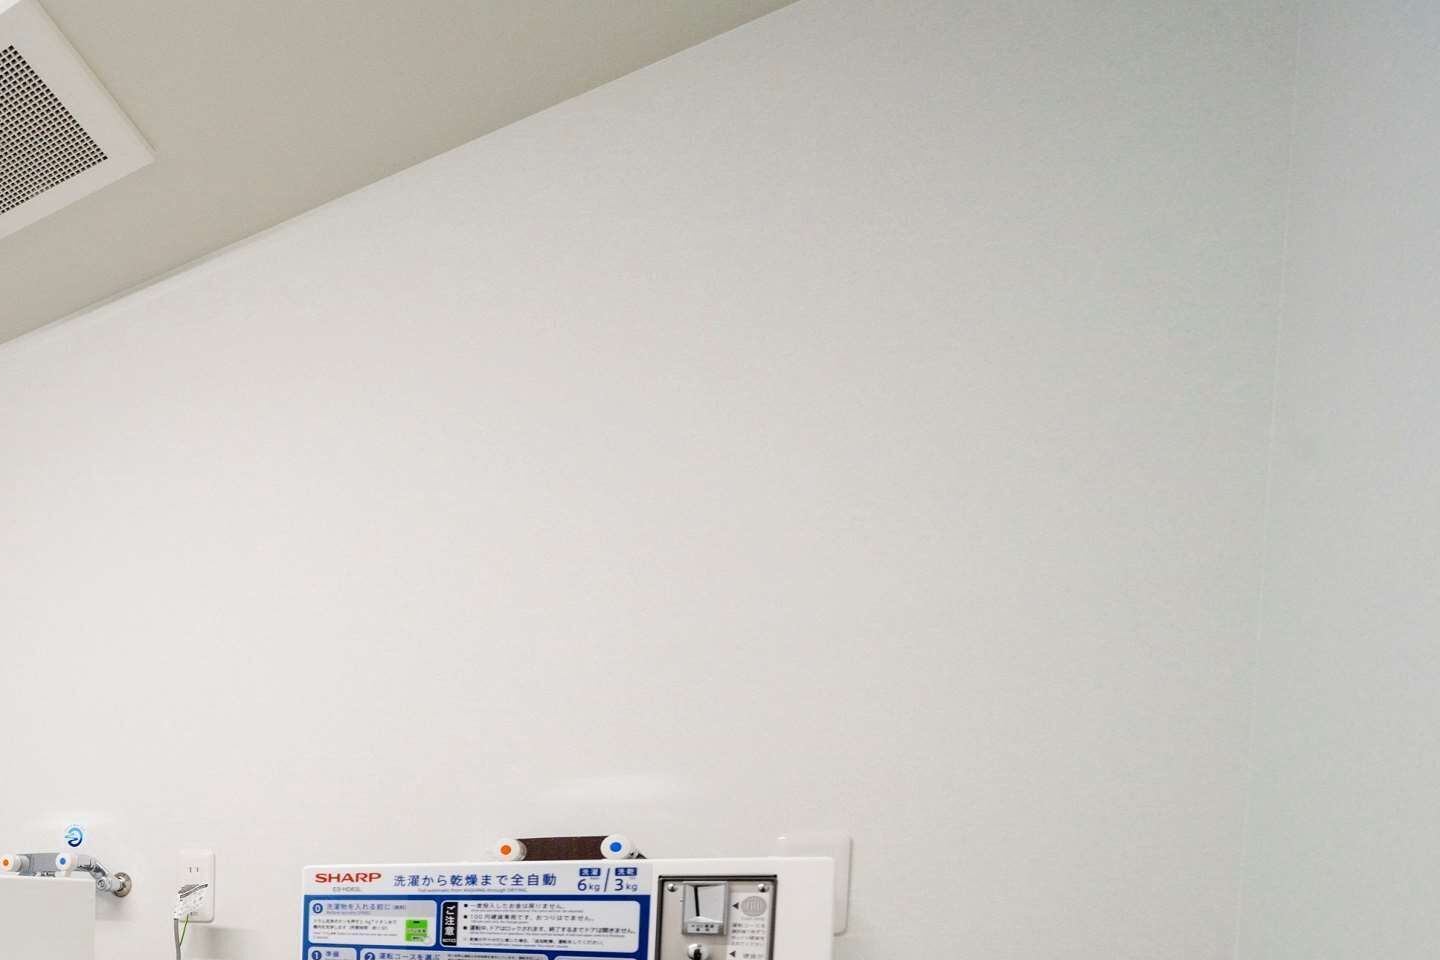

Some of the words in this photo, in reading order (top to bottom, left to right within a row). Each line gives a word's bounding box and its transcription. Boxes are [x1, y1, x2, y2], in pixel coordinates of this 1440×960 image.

[315, 872, 382, 884] SHARP
[394, 873, 557, 887] 洗濯から乾燥まで全自動
